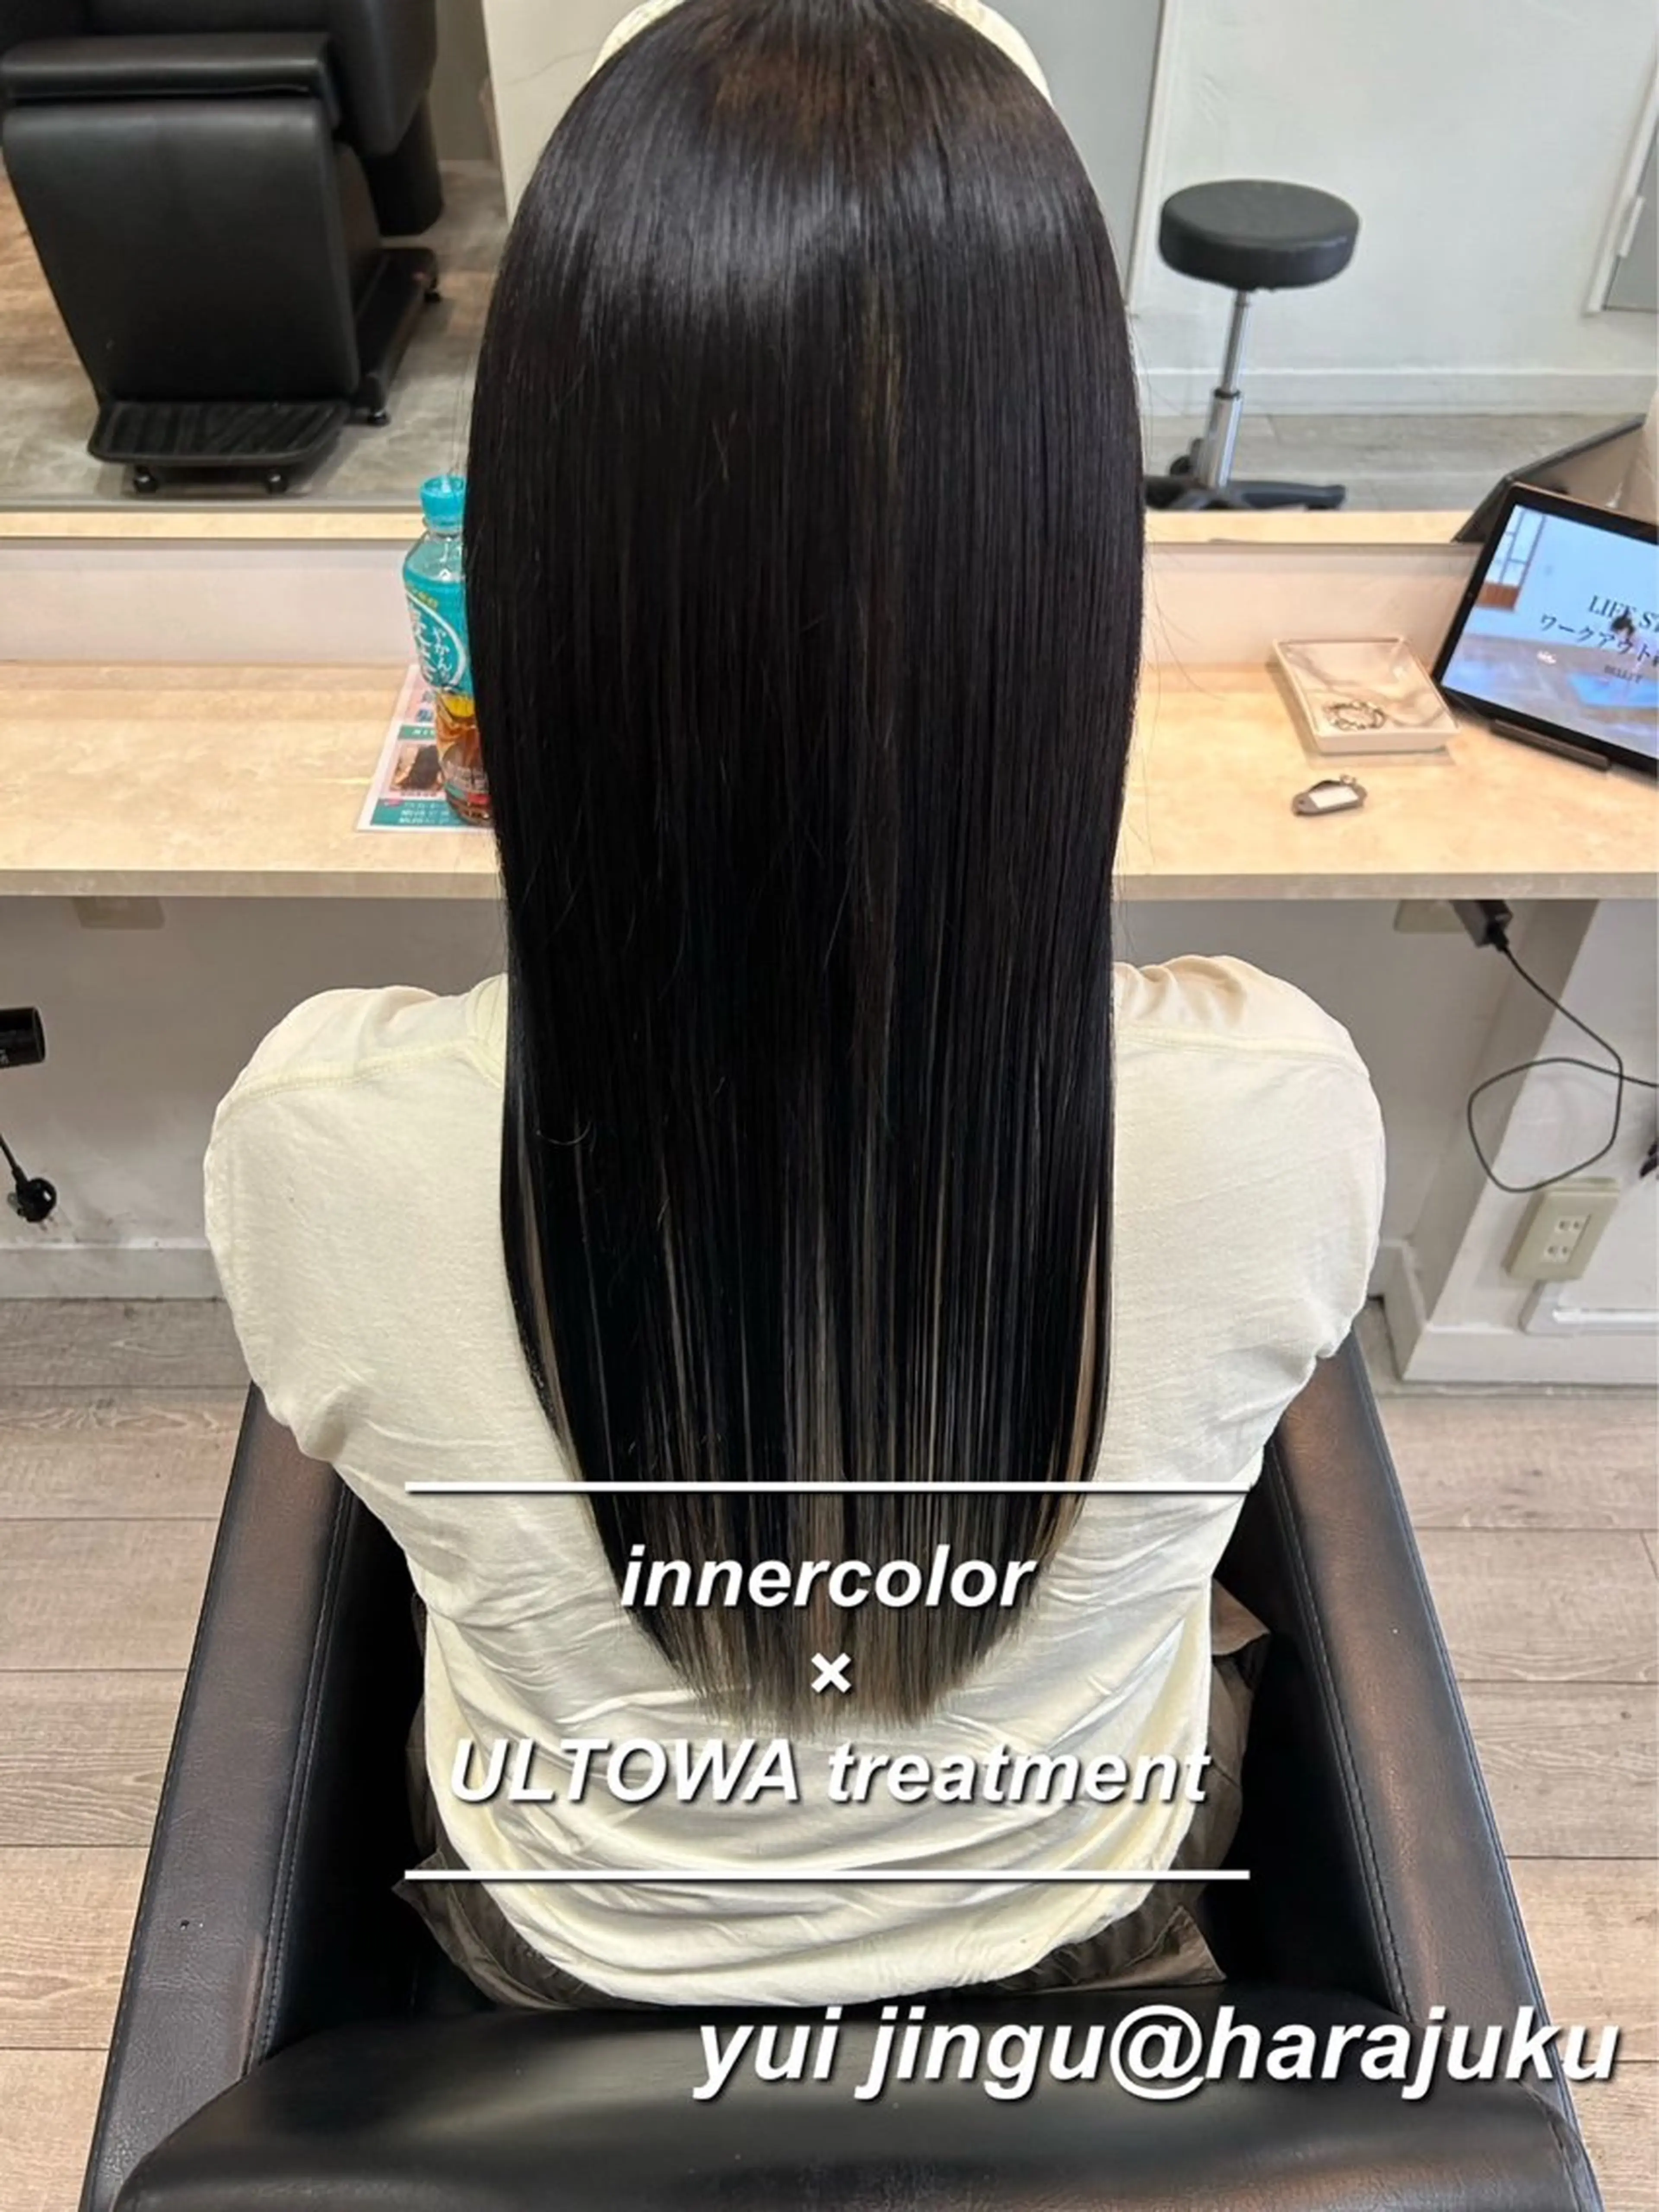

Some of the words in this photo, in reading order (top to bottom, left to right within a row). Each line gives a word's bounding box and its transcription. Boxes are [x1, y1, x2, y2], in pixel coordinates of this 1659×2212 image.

[1540, 613, 1659, 667] ワークアウト
